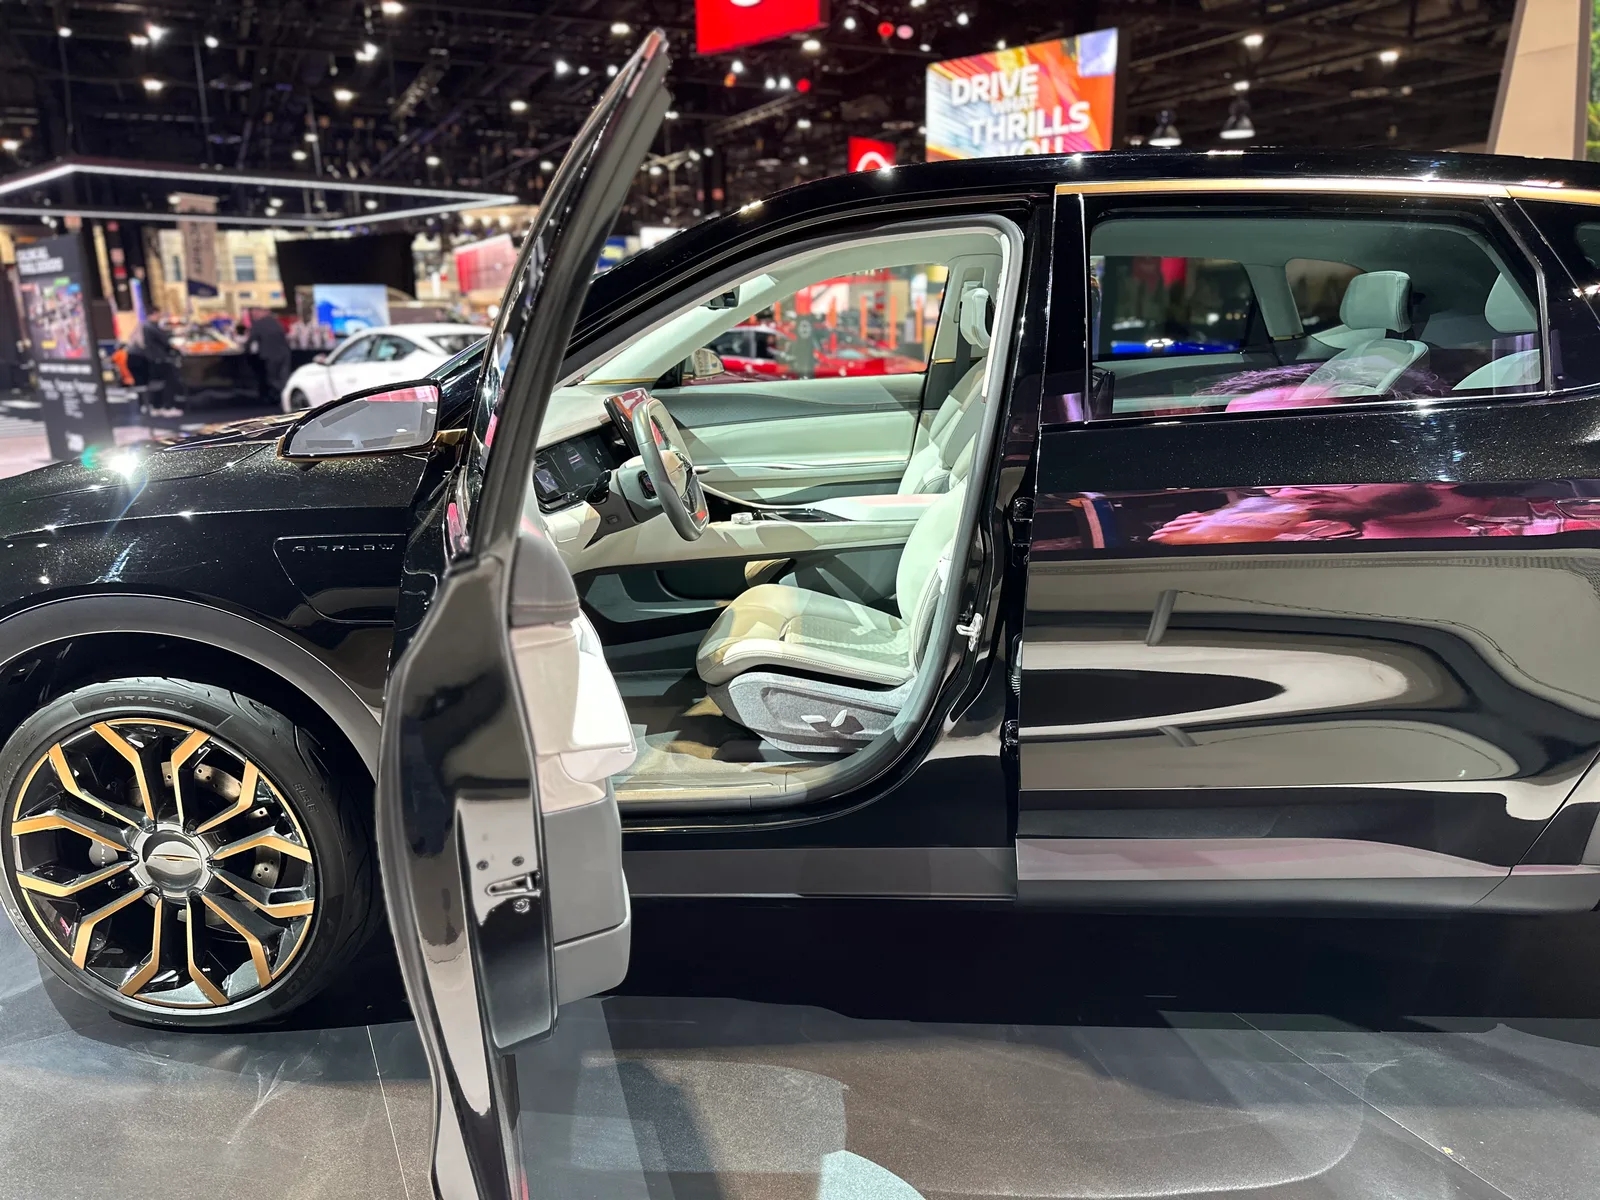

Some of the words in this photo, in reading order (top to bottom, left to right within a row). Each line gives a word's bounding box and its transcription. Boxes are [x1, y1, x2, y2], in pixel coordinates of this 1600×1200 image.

[951, 63, 1039, 106] DRIVE
[968, 101, 1091, 145] THRILLS
[291, 543, 395, 552] AIRFLOW
[103, 694, 194, 710] AIRFLOW
